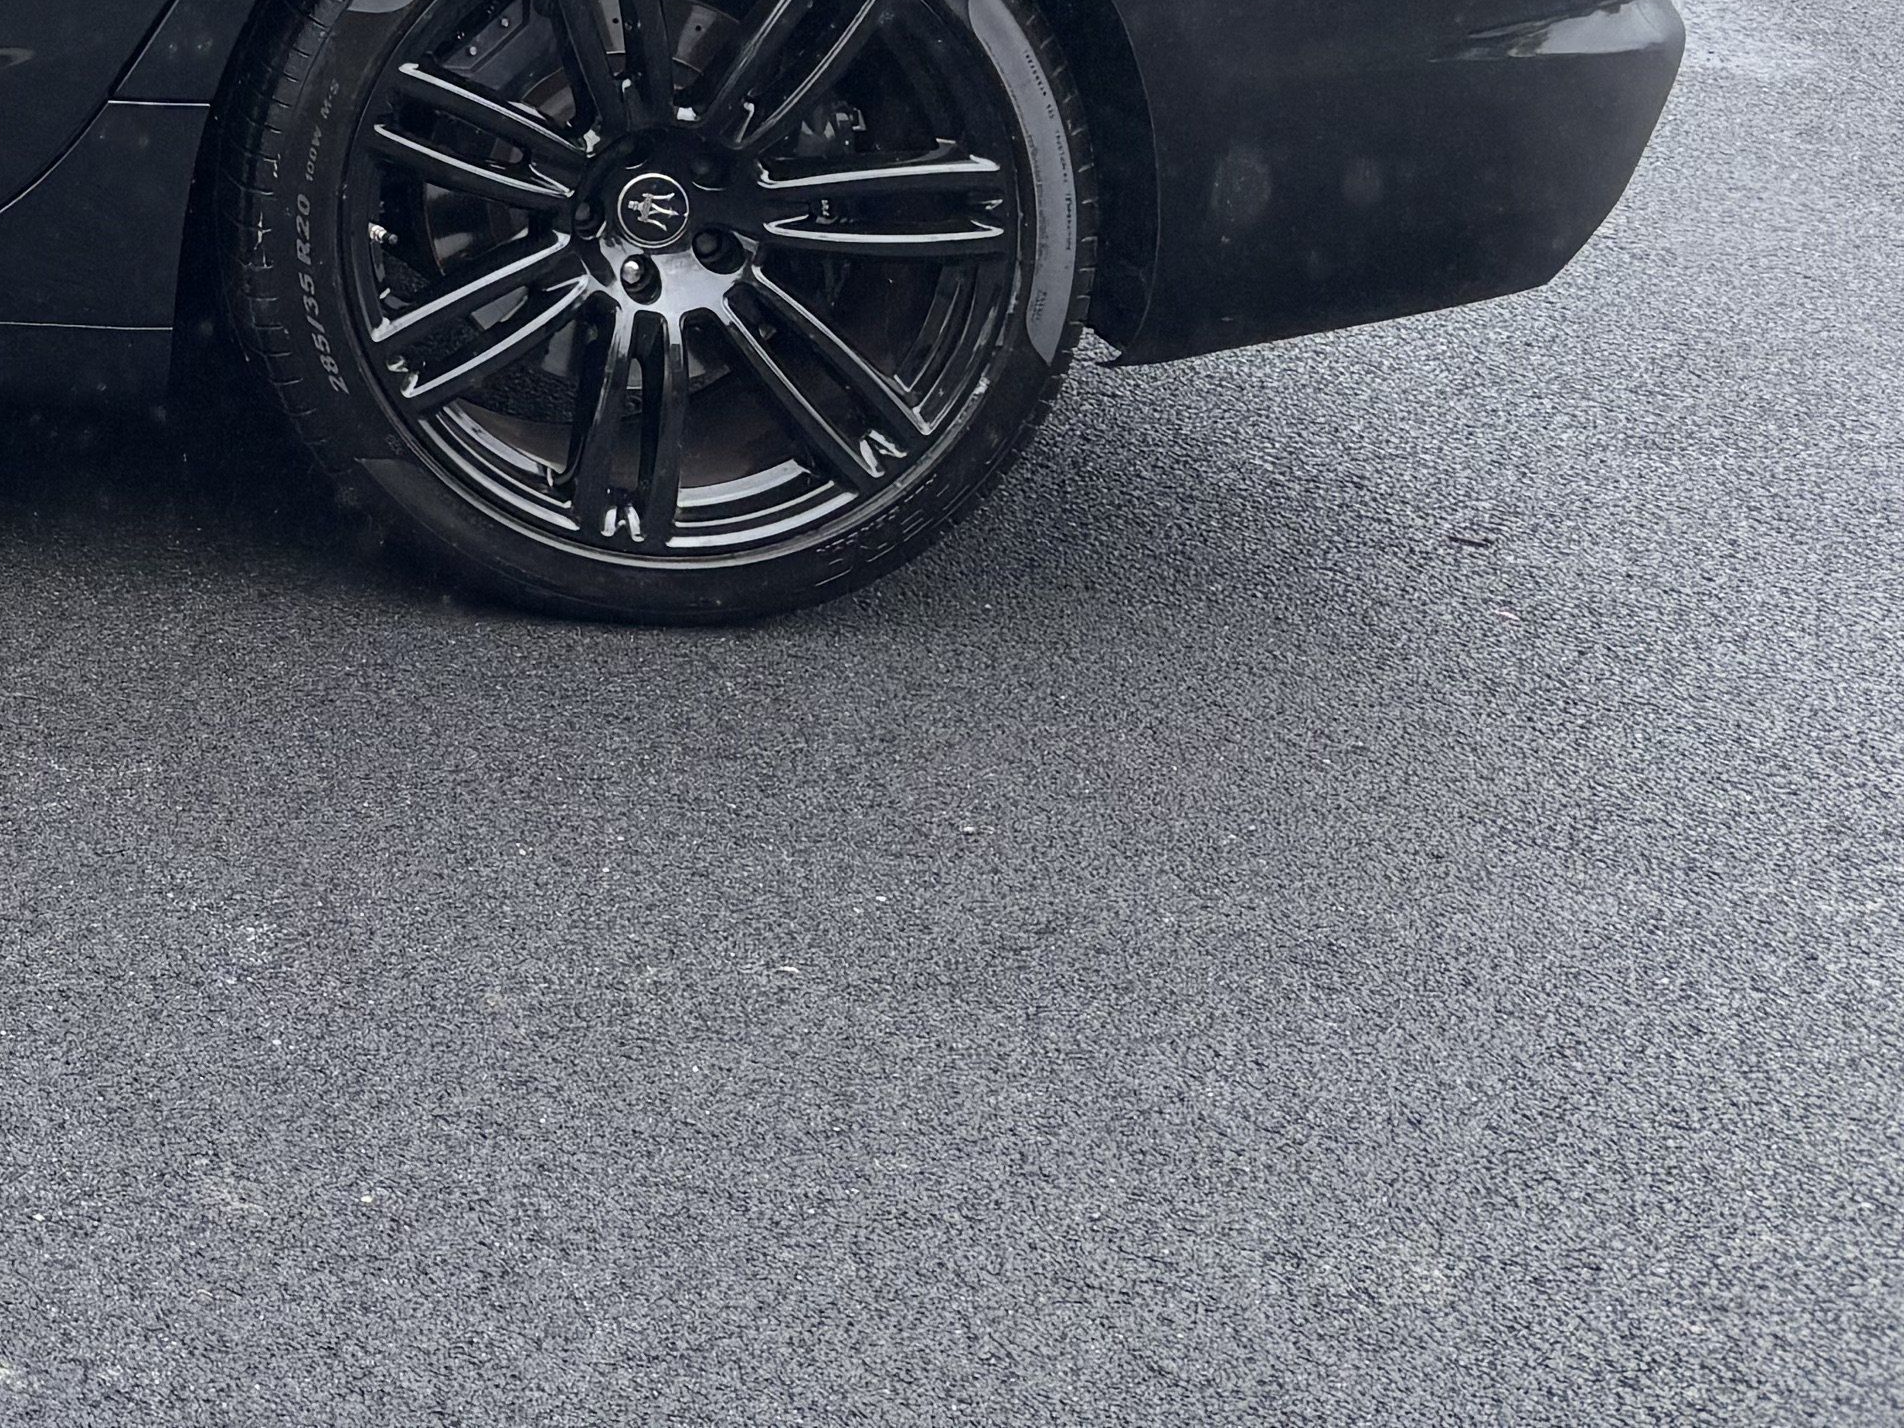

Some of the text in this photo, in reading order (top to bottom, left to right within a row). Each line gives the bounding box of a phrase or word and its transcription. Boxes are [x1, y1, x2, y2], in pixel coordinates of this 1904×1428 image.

[305, 125, 322, 181] 100W
[296, 194, 312, 265] R20
[298, 271, 349, 394] 285/35
